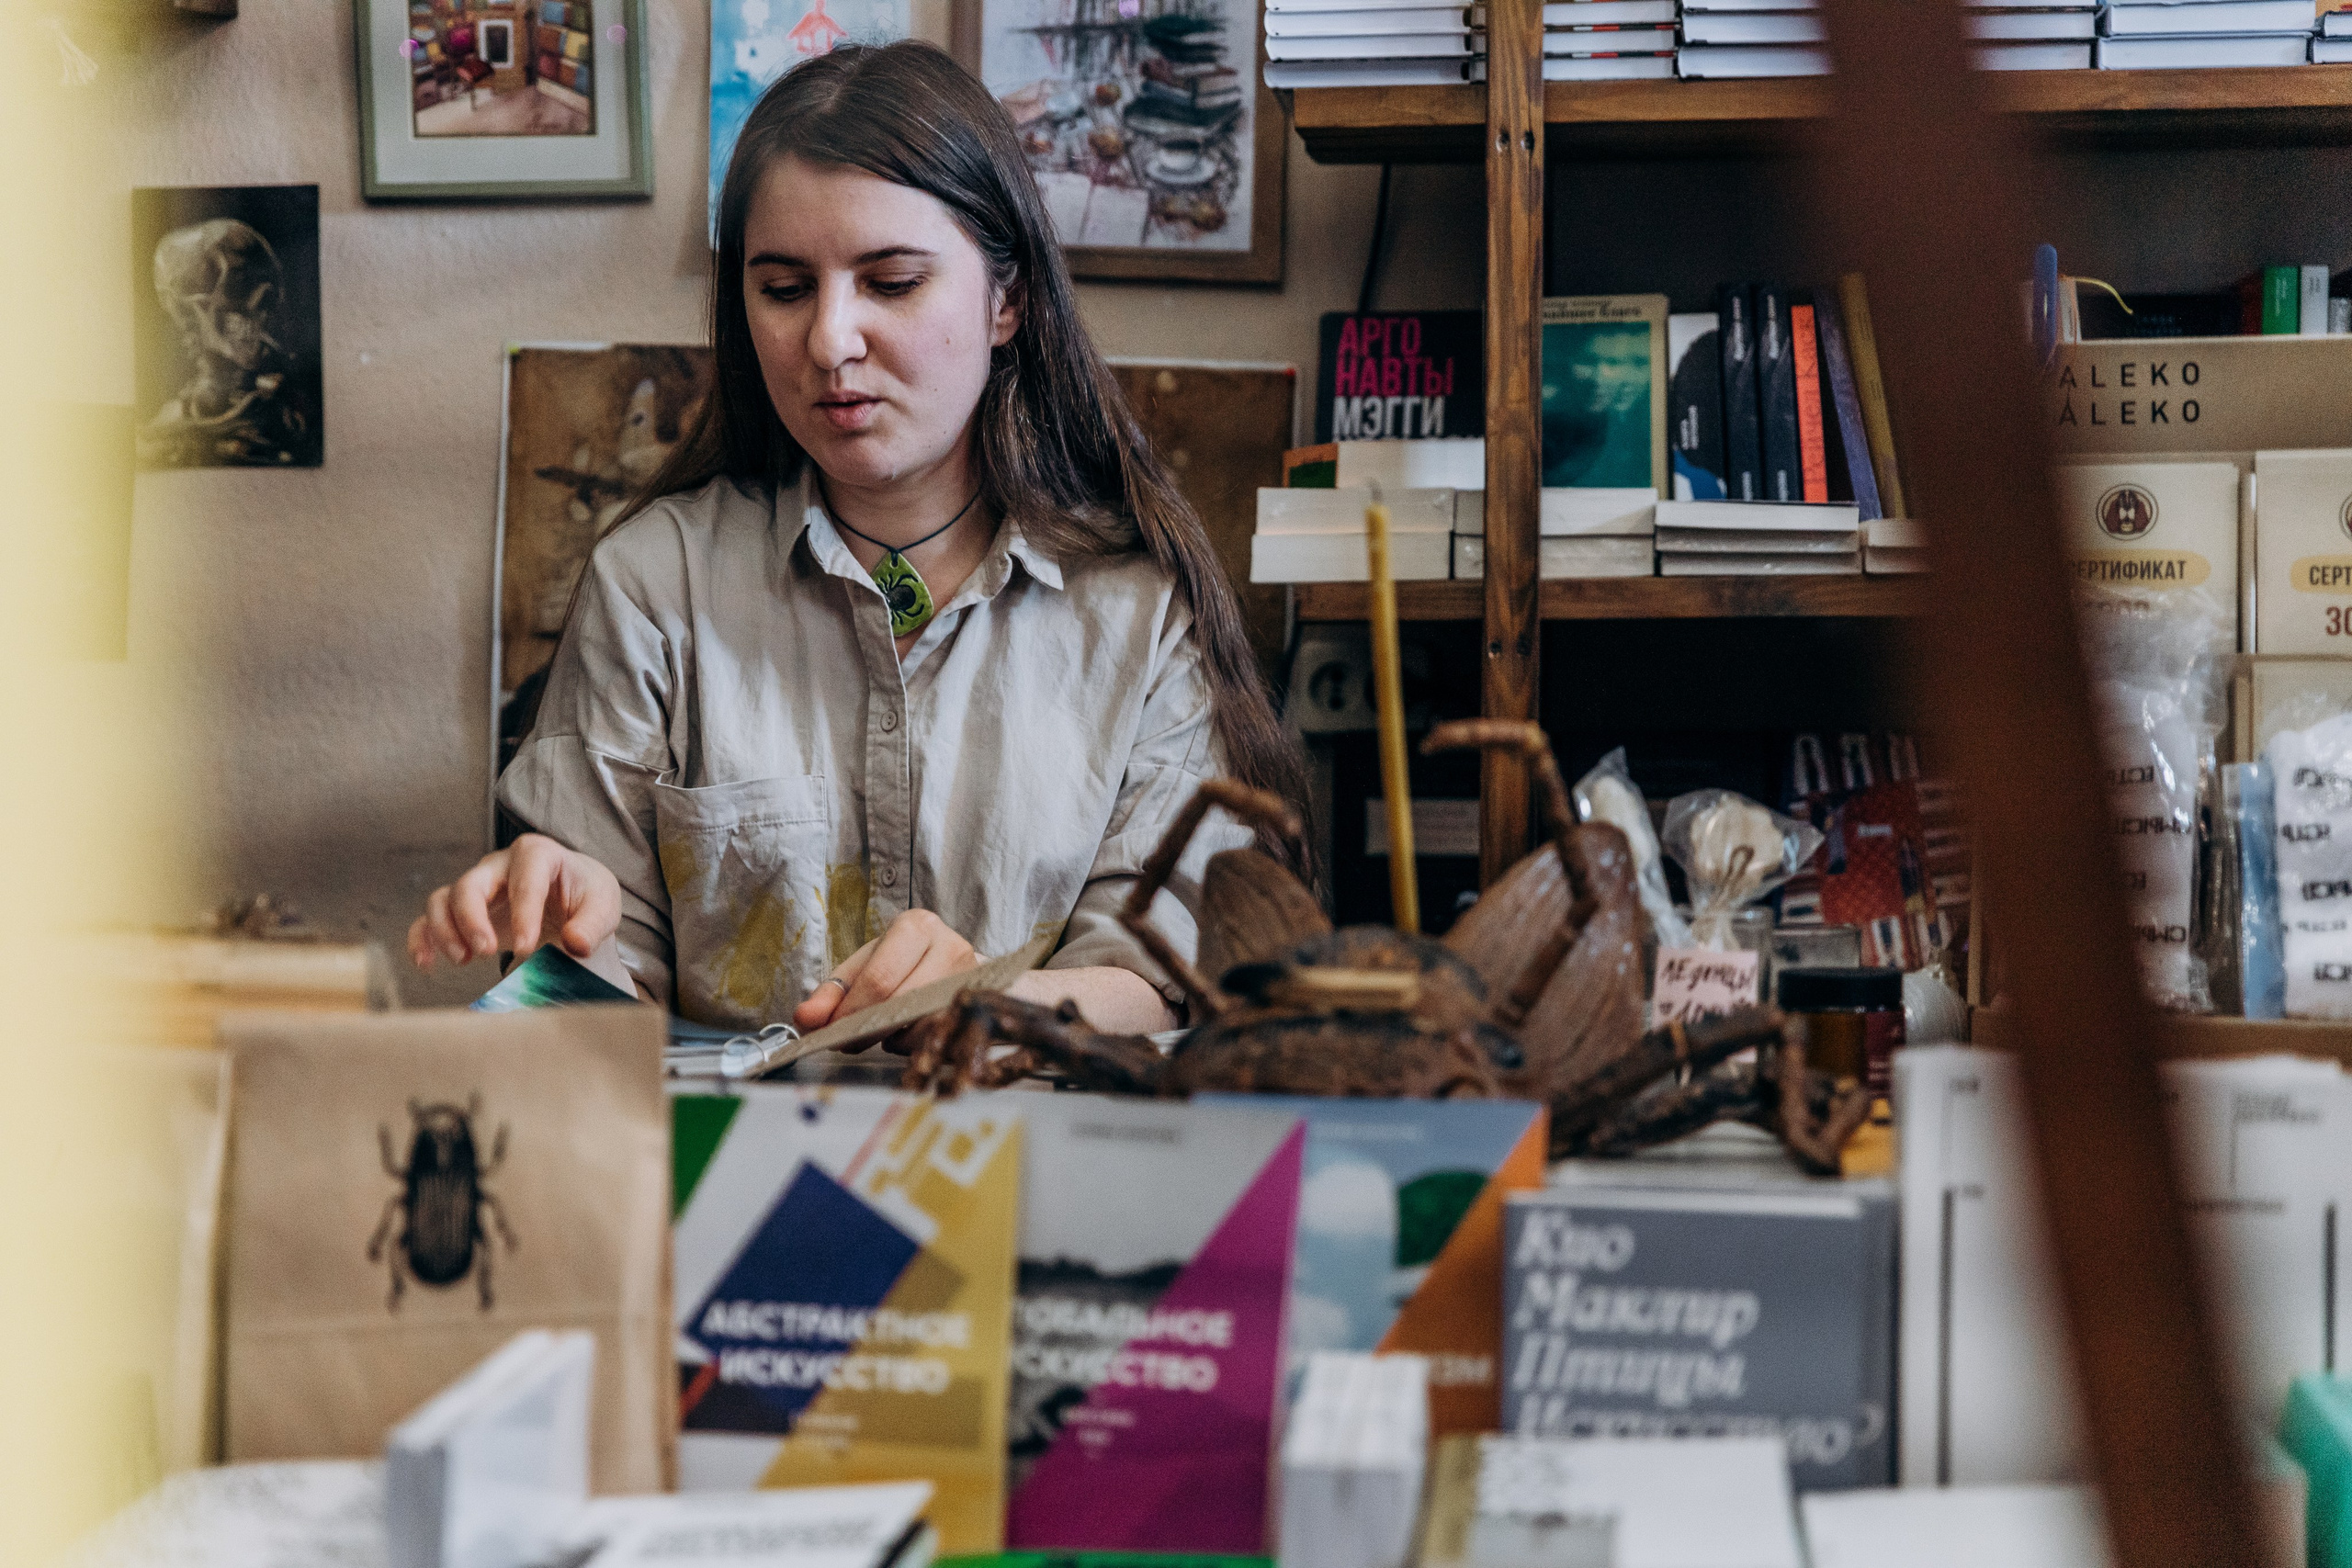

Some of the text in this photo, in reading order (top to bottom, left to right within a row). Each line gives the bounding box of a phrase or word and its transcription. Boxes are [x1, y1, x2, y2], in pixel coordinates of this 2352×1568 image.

[1338, 317, 1421, 356] АРГО
[1335, 356, 1453, 397] НАВТЫ
[2059, 361, 2200, 389] ALEKO
[1332, 396, 1445, 437] МЭГГИ
[2058, 399, 2200, 427] ALEKO
[702, 1301, 970, 1348] АБСТРАКТНОЕ
[1012, 1296, 1234, 1348] ОБАЛЬНОЕ
[719, 1349, 950, 1394] ИСКУССТВО
[1009, 1345, 1220, 1393] СКУССТВО
[1512, 1333, 1745, 1407] Птицы
